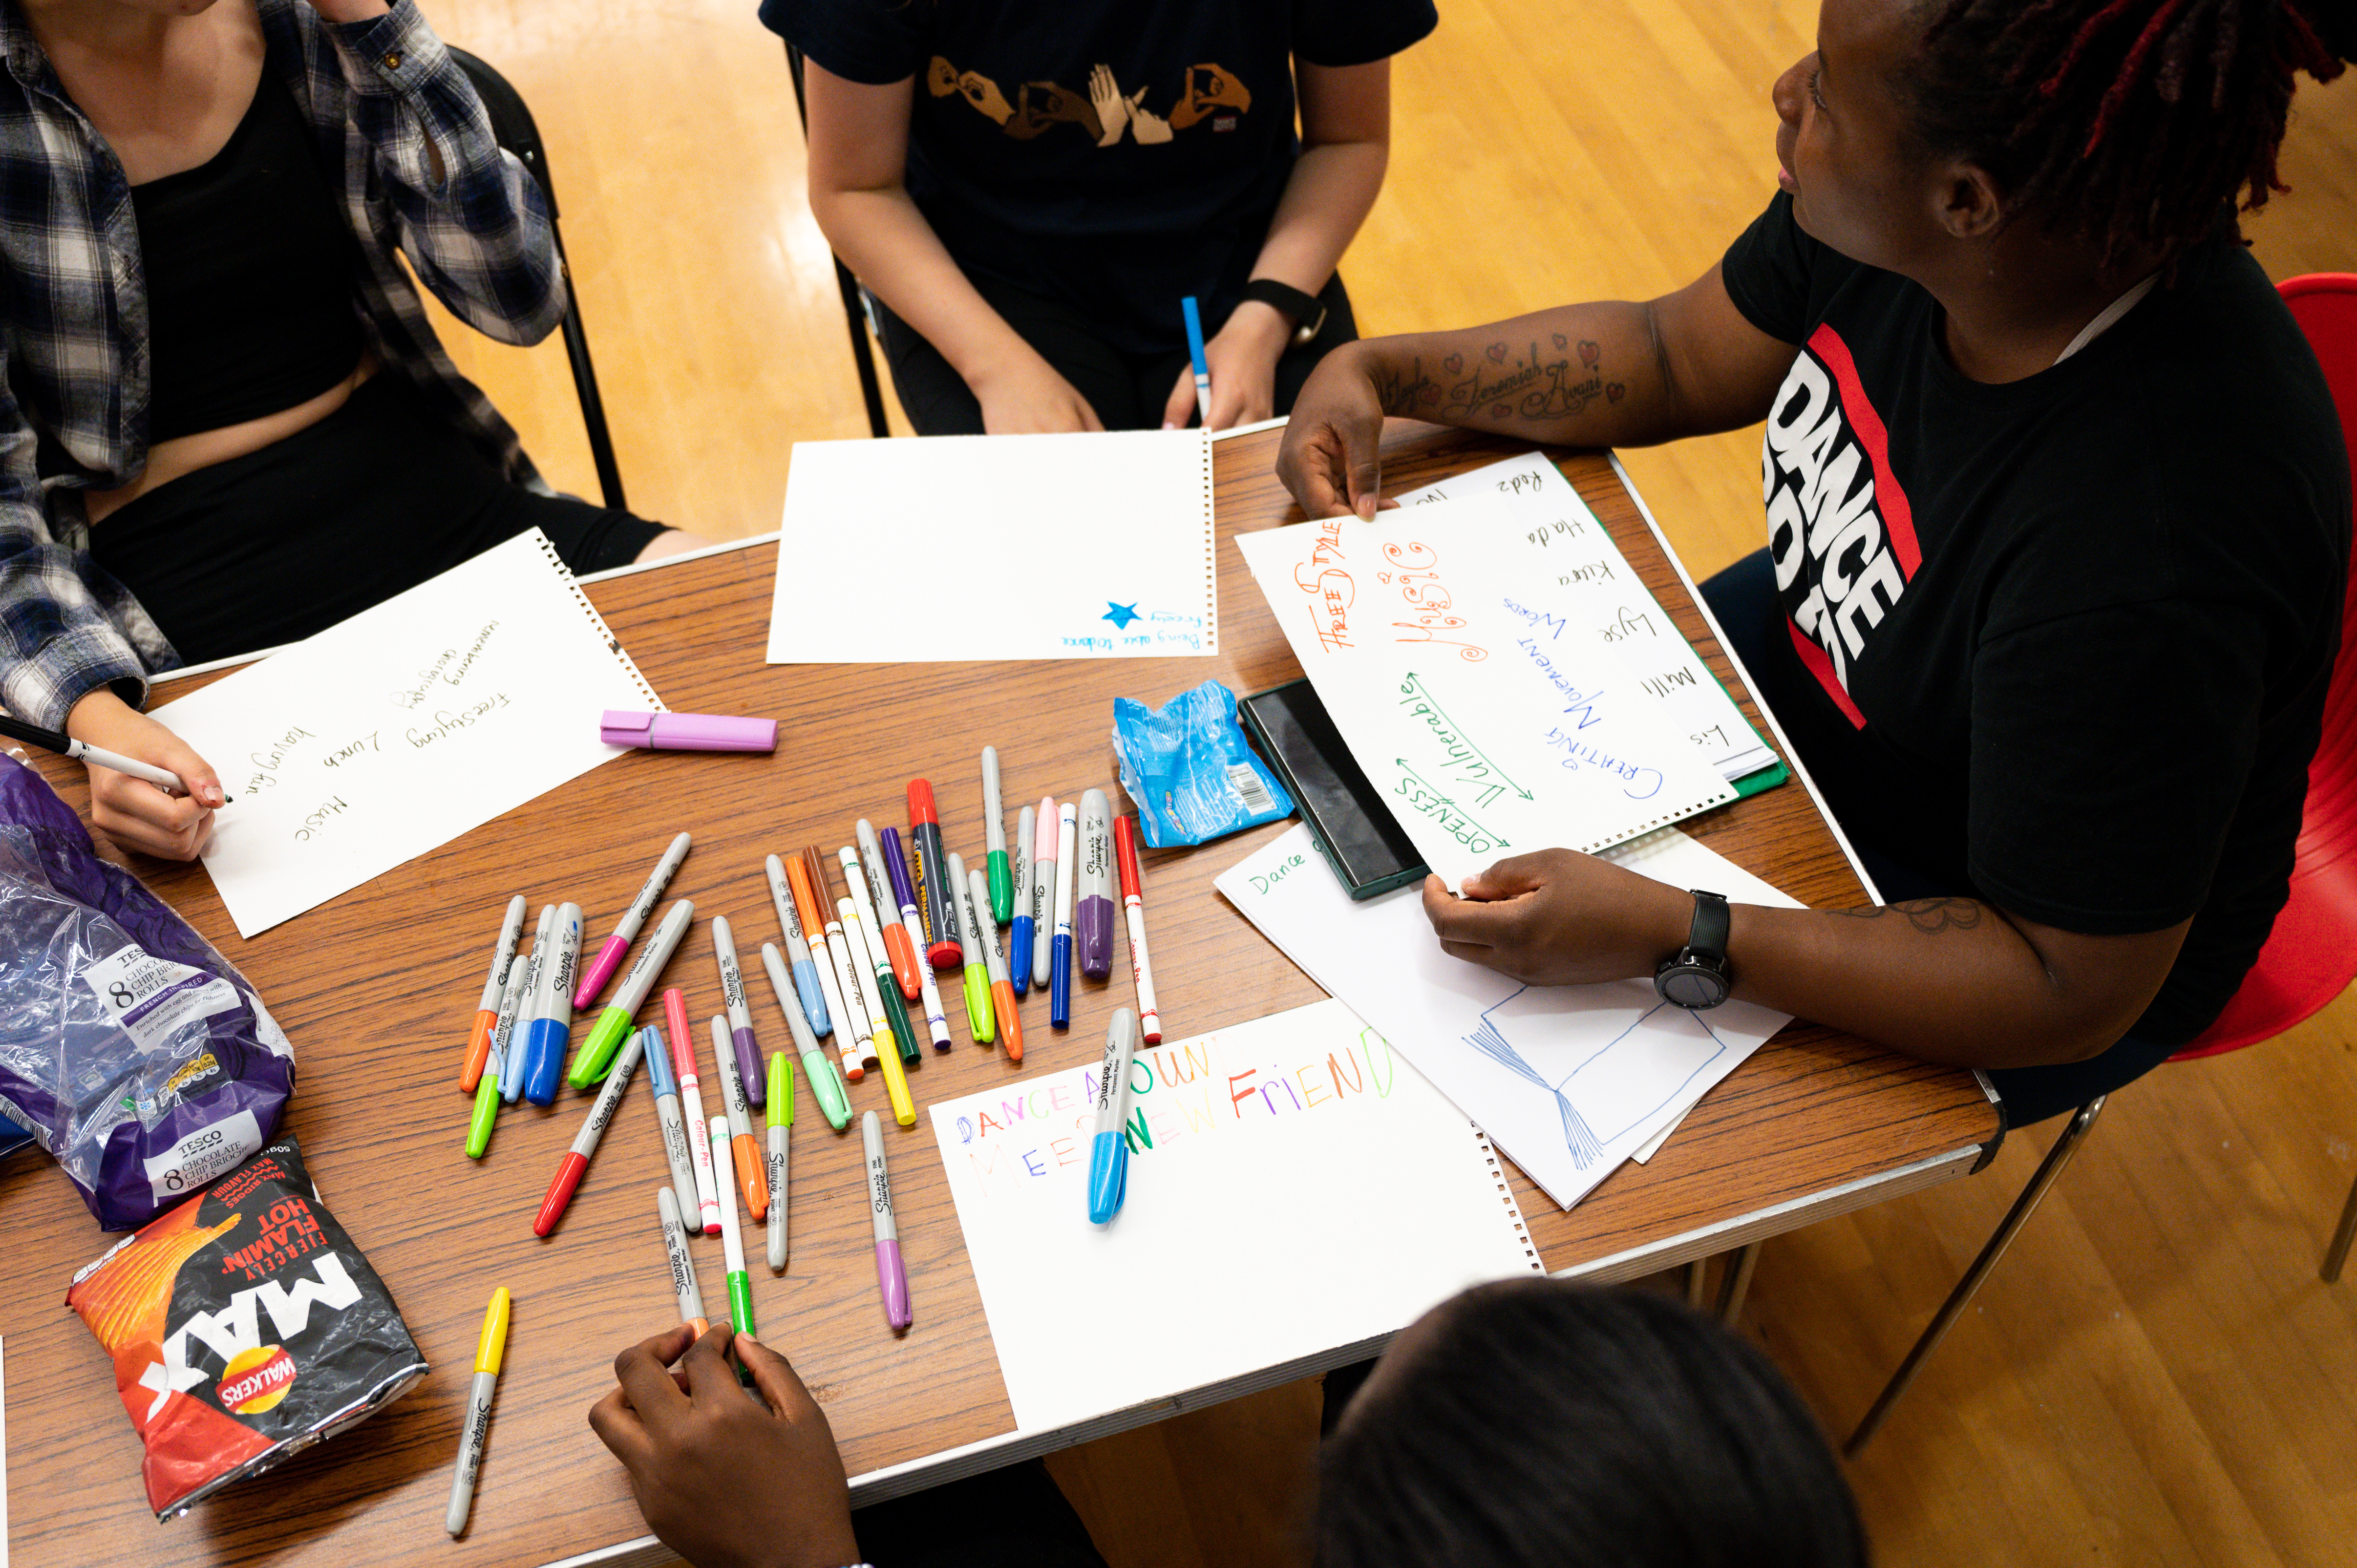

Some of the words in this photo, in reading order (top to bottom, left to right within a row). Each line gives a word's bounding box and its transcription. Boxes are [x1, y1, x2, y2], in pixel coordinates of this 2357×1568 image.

[1497, 470, 1542, 495] Redz
[1767, 349, 1904, 662] DANCE
[1157, 630, 1200, 650] Being
[295, 795, 348, 841] Music
[1086, 834, 1106, 879] Sharpie
[1248, 851, 1306, 895] Dance
[919, 886, 933, 943] PERMANENT
[116, 946, 146, 966] TES
[129, 972, 157, 991] CHIP
[155, 957, 182, 976] BRIO
[554, 952, 573, 998] Sharpie
[635, 954, 650, 974] Permanent
[648, 942, 658, 954] Marker
[105, 976, 137, 1013] 8
[123, 955, 166, 983] CHOCO
[134, 975, 170, 999] ROLLS
[139, 990, 169, 1013] FRENCH
[136, 1011, 161, 1031] Enriched
[159, 1002, 173, 1015] with
[171, 996, 184, 1007] egg
[181, 991, 193, 1001] and
[142, 1026, 156, 1038] dark
[154, 1010, 181, 1029] chocolate
[203, 1059, 216, 1069] 0.25g
[735, 1076, 748, 1113] Sharpie
[956, 1084, 1076, 1147] DANCE
[1085, 1033, 1246, 1105] AOUND
[1099, 1060, 1112, 1110] Sharpie
[1110, 1073, 1119, 1095] Permanent
[592, 1095, 618, 1132] Sharpie
[1125, 1086, 1216, 1155] NEW
[178, 1129, 222, 1154] TESCO
[694, 1121, 708, 1166] Colour-Pen
[162, 1167, 186, 1193] 8
[181, 1141, 242, 1172] CHOCOLATE
[184, 1164, 209, 1181] CHIP
[186, 1170, 216, 1188] ROLLS
[211, 1169, 250, 1199] FLAVOUR
[247, 1157, 274, 1177] MAX
[226, 1179, 264, 1208] RIDGES
[874, 1173, 891, 1216] Sharpie
[257, 1199, 311, 1236] HOT
[245, 1231, 329, 1281] FIERCELY
[672, 1251, 690, 1297] Sharpie
[138, 1251, 363, 1425] MAX
[220, 1356, 297, 1408] WALKERS
[471, 1398, 490, 1449] Sharpie
